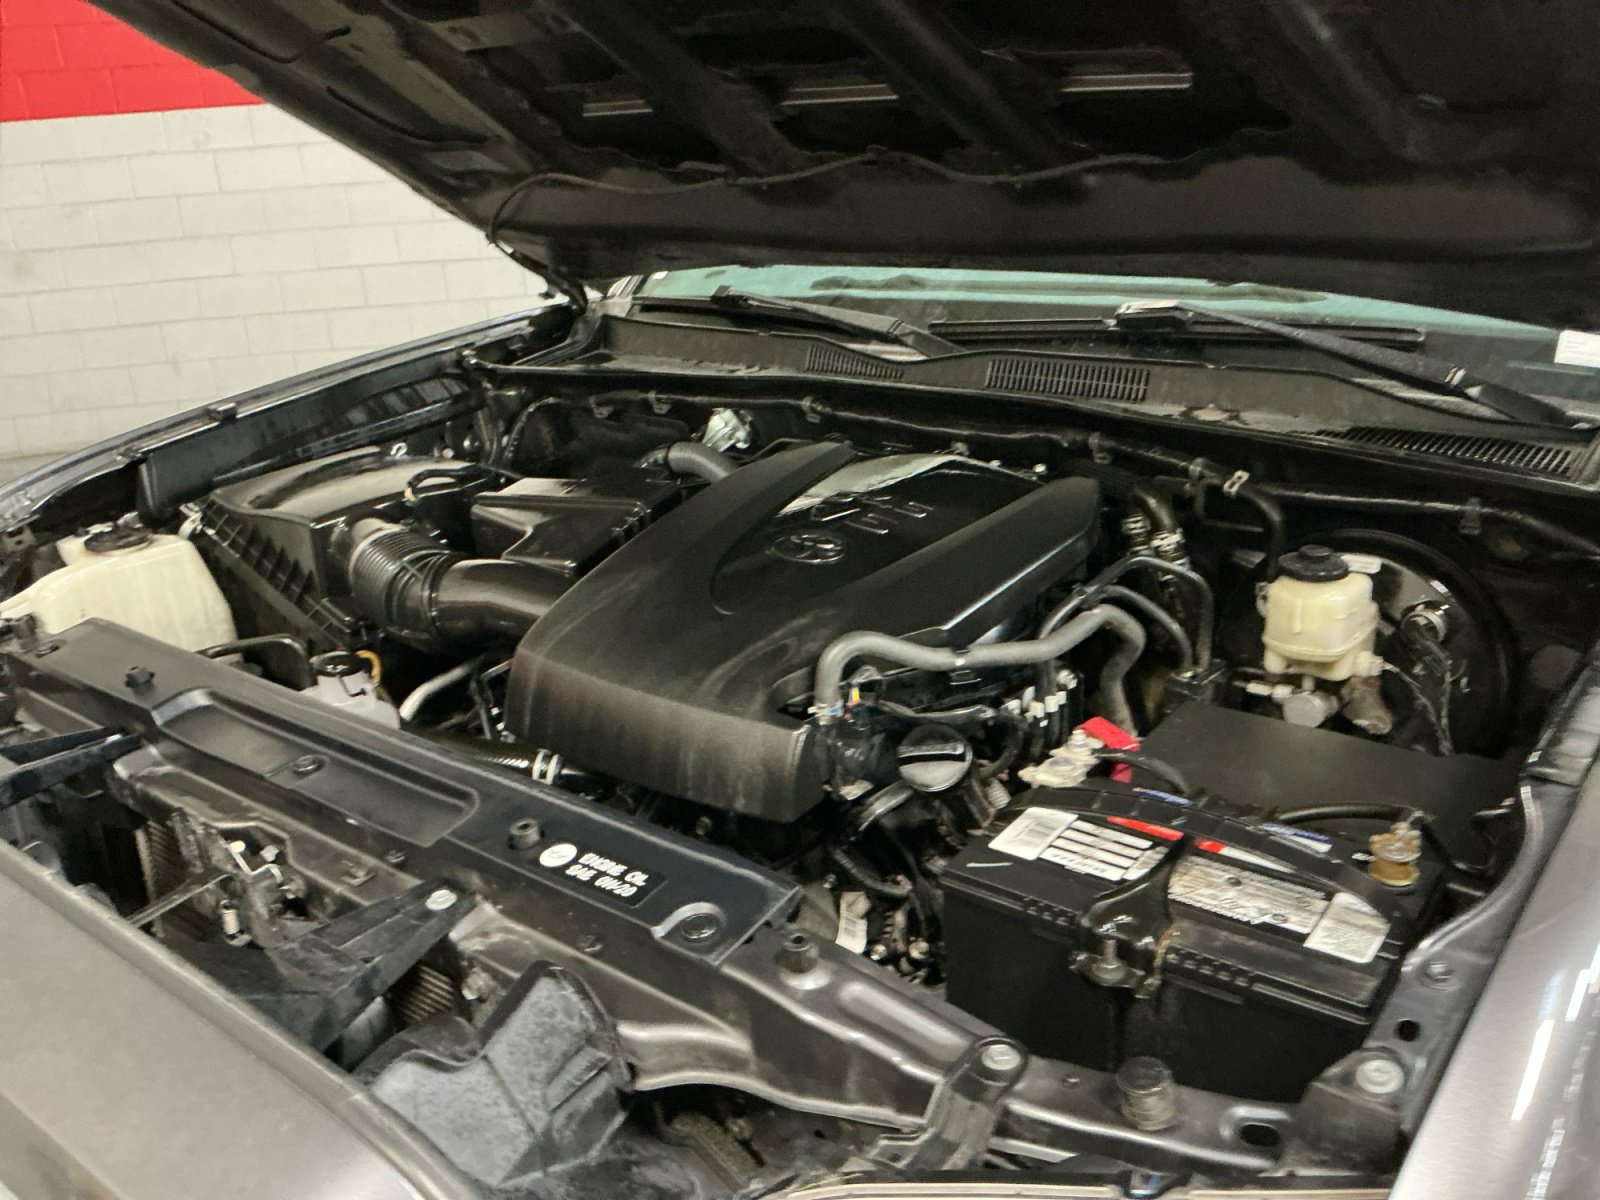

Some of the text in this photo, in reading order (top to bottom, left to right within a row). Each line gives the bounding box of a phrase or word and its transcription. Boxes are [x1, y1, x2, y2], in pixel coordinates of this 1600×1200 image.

[565, 864, 598, 881] SAE
[577, 852, 650, 887] ENGINE OIL
